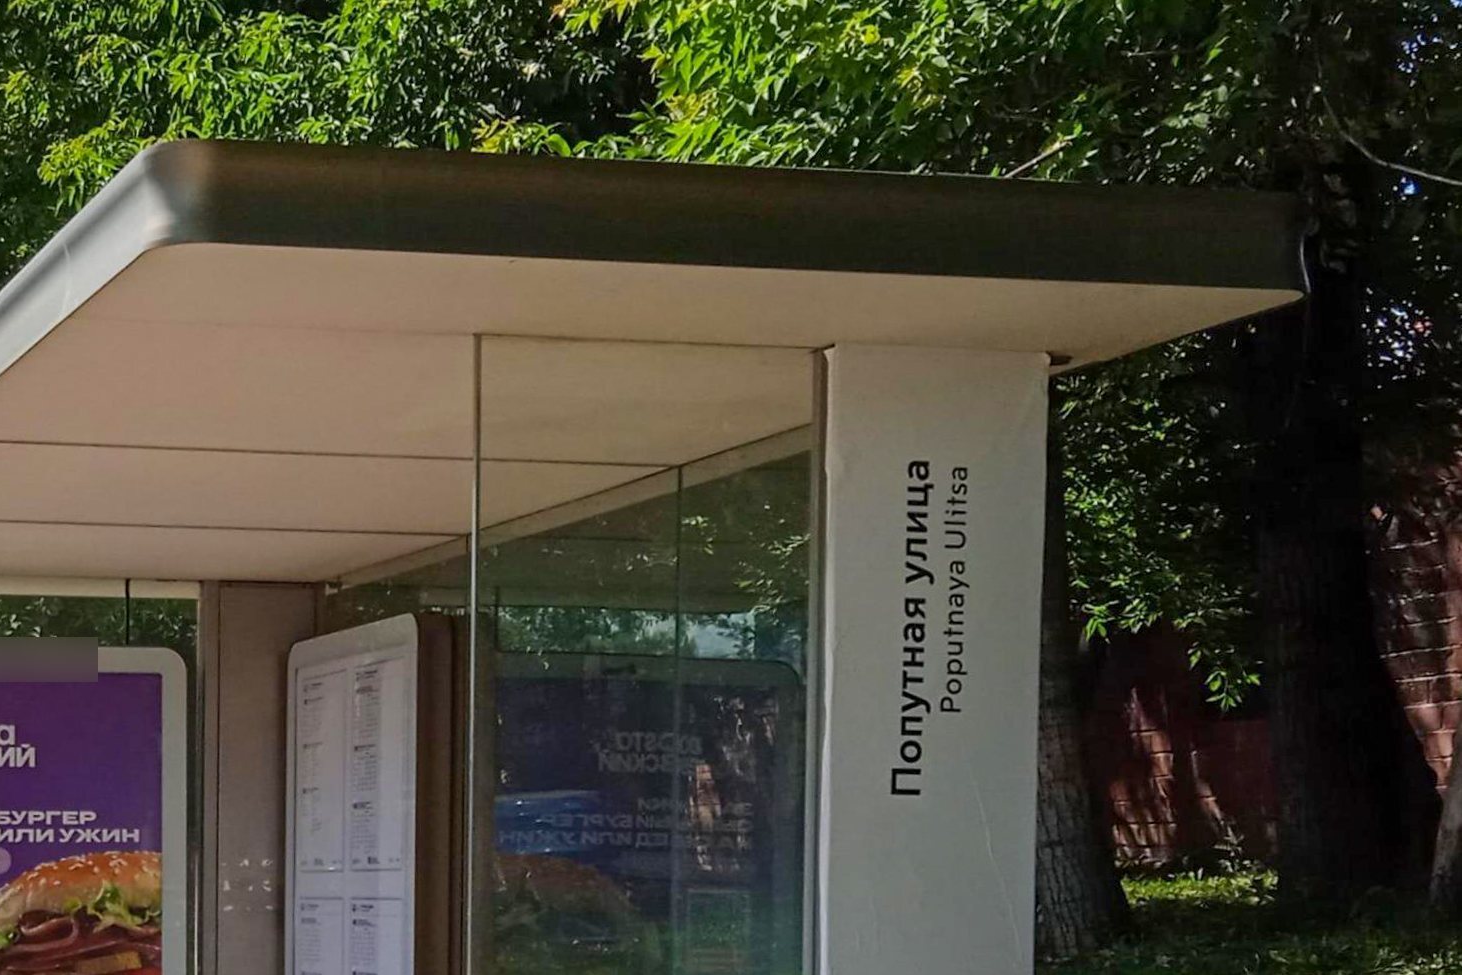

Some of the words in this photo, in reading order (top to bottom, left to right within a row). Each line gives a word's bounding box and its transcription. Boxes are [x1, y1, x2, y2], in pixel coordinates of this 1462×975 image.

[904, 460, 935, 585] улица
[944, 465, 969, 550] Ulitsa
[890, 597, 931, 796] Попутная
[940, 559, 970, 713] Poputnaya
[59, 828, 140, 843] УЖИН
